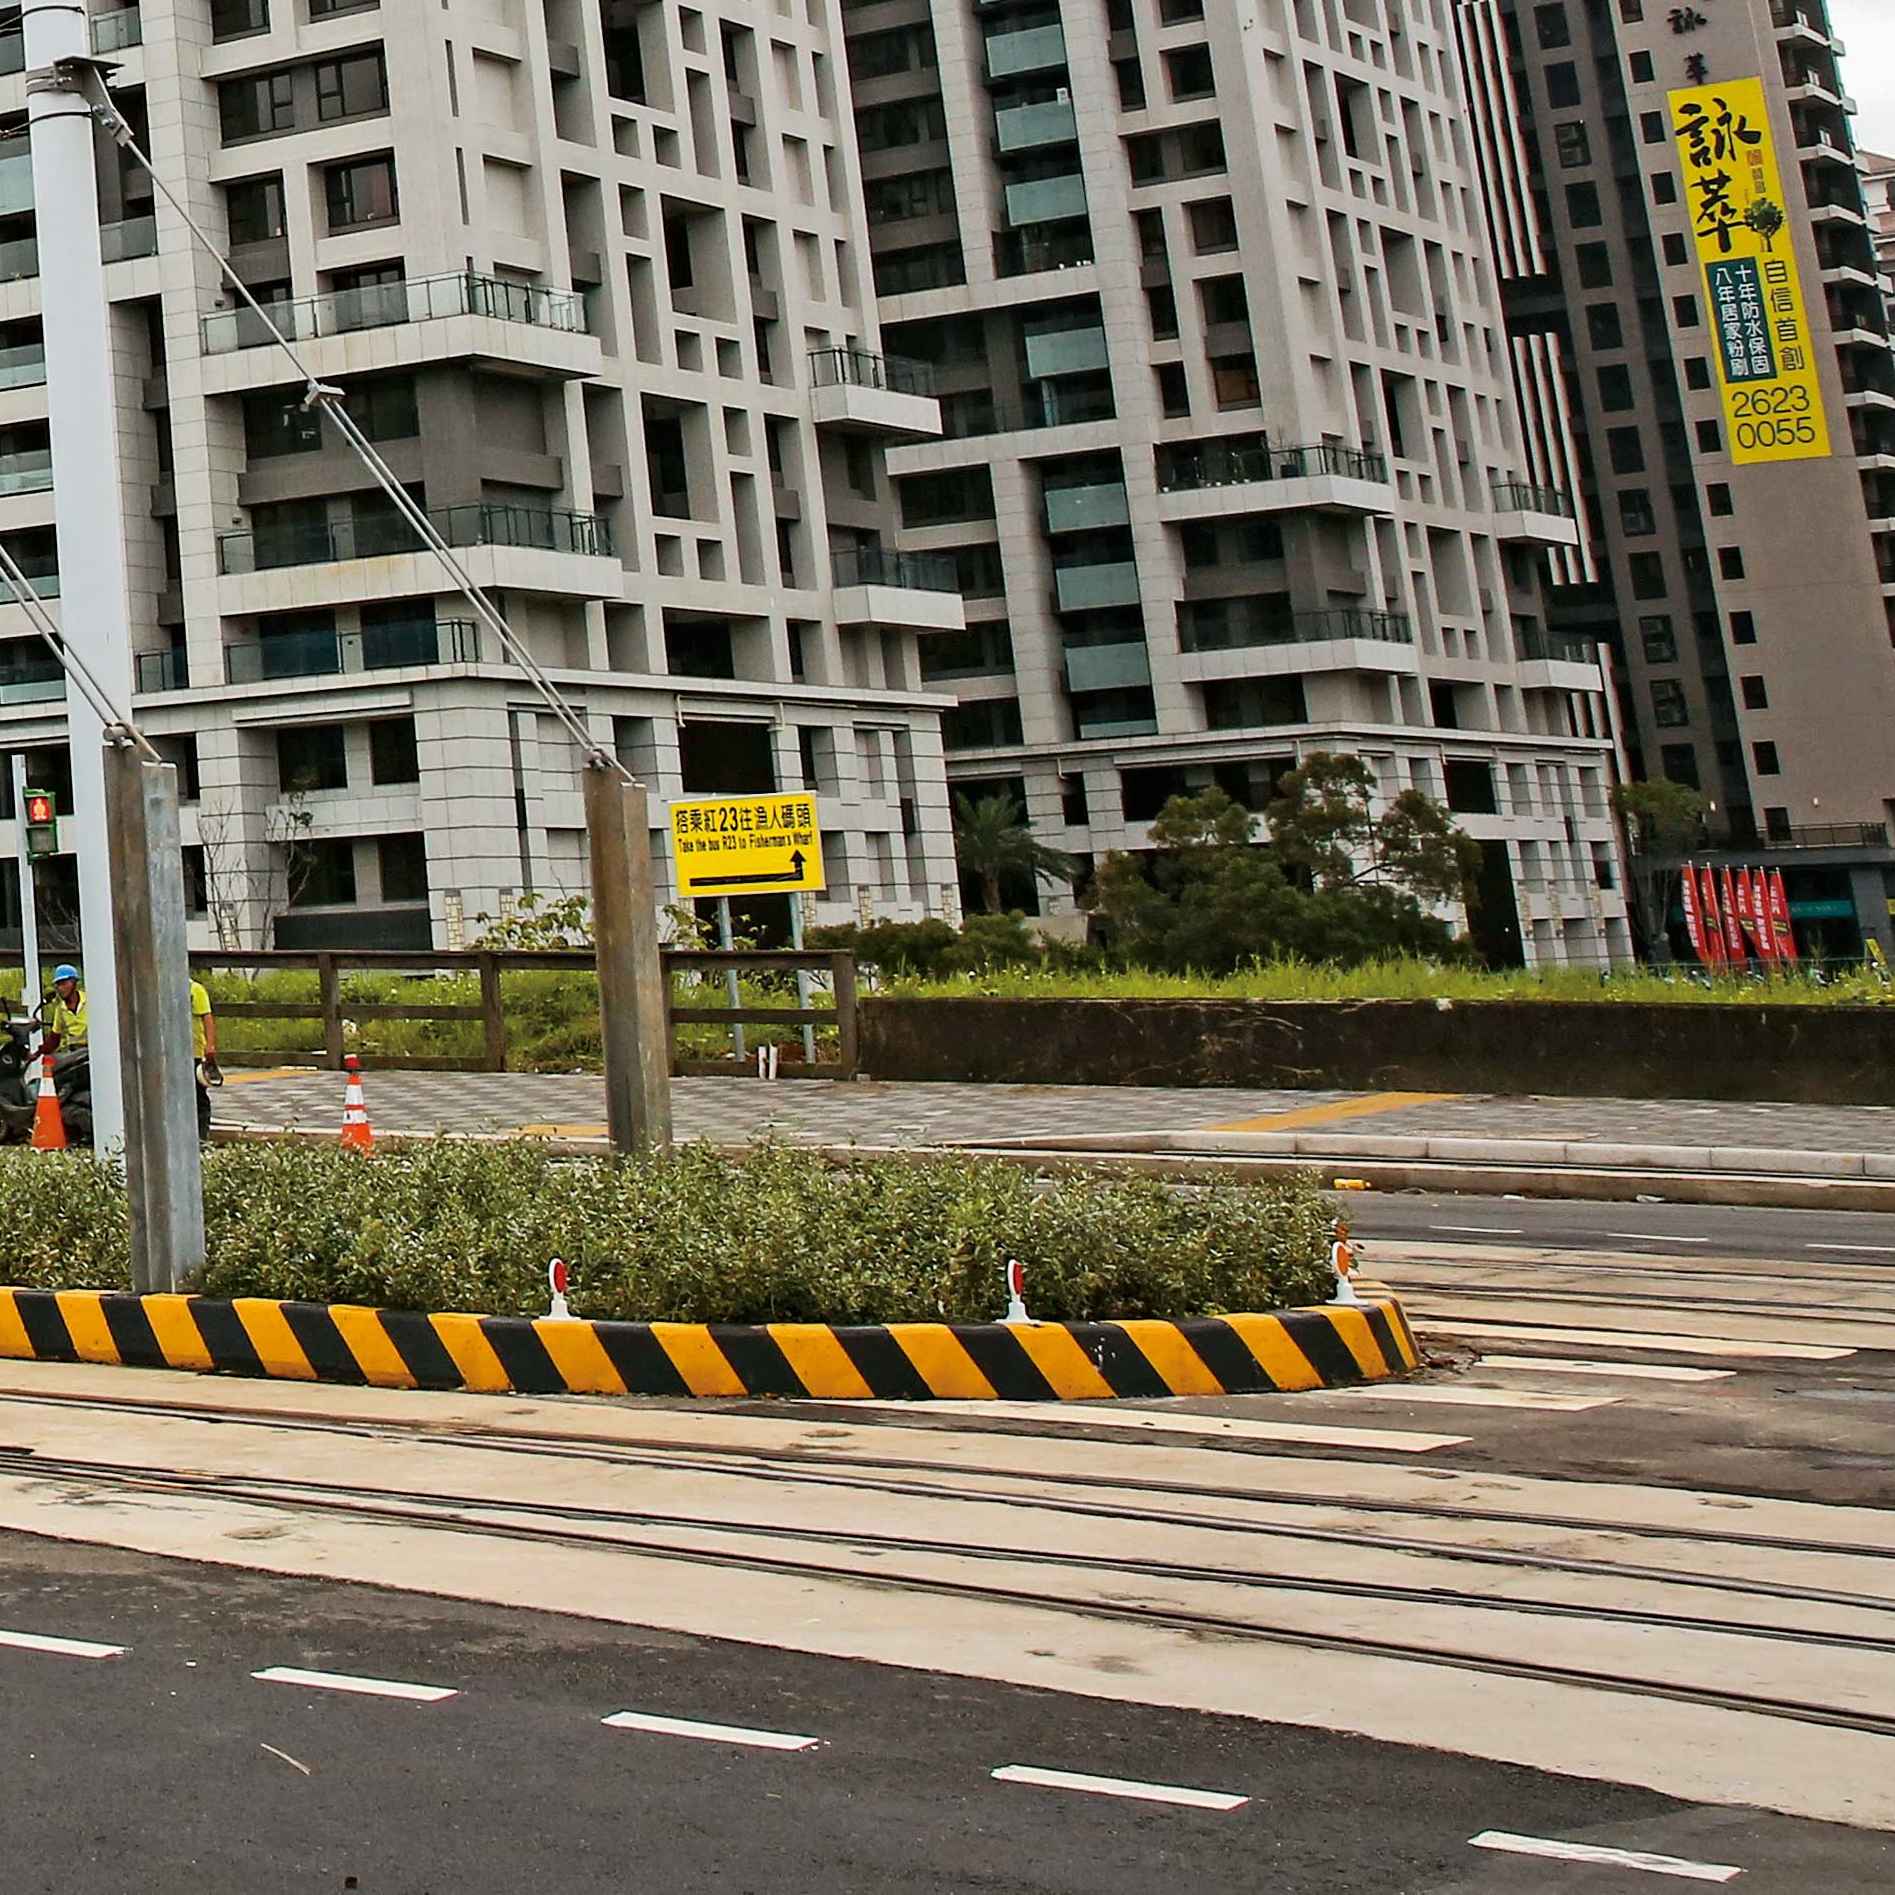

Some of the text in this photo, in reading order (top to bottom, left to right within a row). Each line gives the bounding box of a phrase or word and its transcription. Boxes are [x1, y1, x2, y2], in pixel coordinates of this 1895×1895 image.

[1714, 266, 1750, 377] 八年居家粉刷
[1734, 264, 1771, 375] 十年防水保固
[1764, 259, 1805, 372] 自信首創
[1730, 384, 1811, 420] 2623
[1736, 415, 1817, 450] 0055
[675, 803, 812, 834] 搭乘紅23往漁人碼頭
[678, 838, 694, 853] Take
[696, 837, 707, 852] the
[708, 836, 721, 852] bus
[722, 835, 738, 850] R23
[739, 836, 747, 849] to
